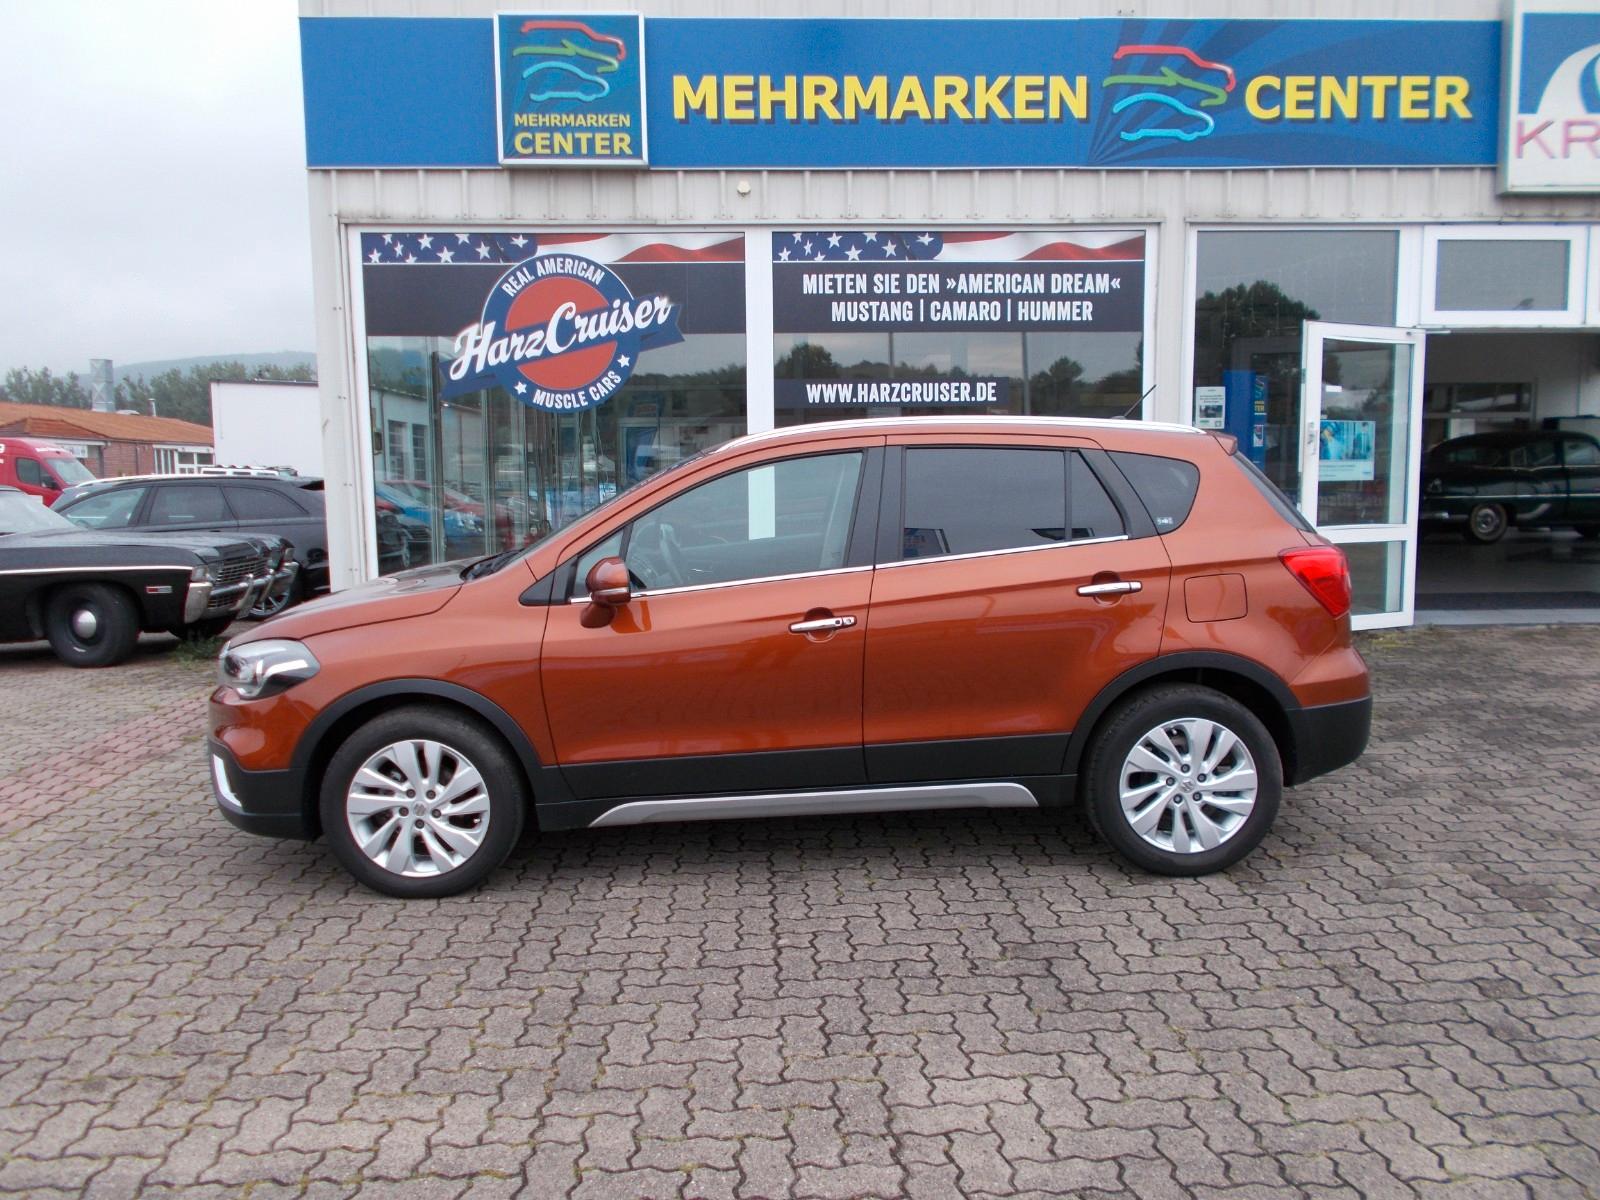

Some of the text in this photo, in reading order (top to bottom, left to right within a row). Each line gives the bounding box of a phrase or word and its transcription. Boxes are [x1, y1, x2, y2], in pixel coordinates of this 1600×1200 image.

[673, 75, 1472, 120] MEHRMARKEN CENTER
[514, 113, 631, 127] MEHRMARKEN
[514, 132, 633, 155] CENTER
[502, 257, 606, 297] REAL AMERICAN
[802, 273, 867, 294] MIETEN
[873, 273, 901, 294] SIE
[906, 273, 940, 294] DEN
[831, 301, 913, 322] MUSTANG
[930, 301, 1001, 322] CAMARO
[1017, 301, 1093, 321] HUMMER
[449, 295, 672, 381] HarzCruiser
[532, 370, 622, 409] MUSCLE CARS
[806, 382, 997, 404] WWW.HARZCRUISER.DE
